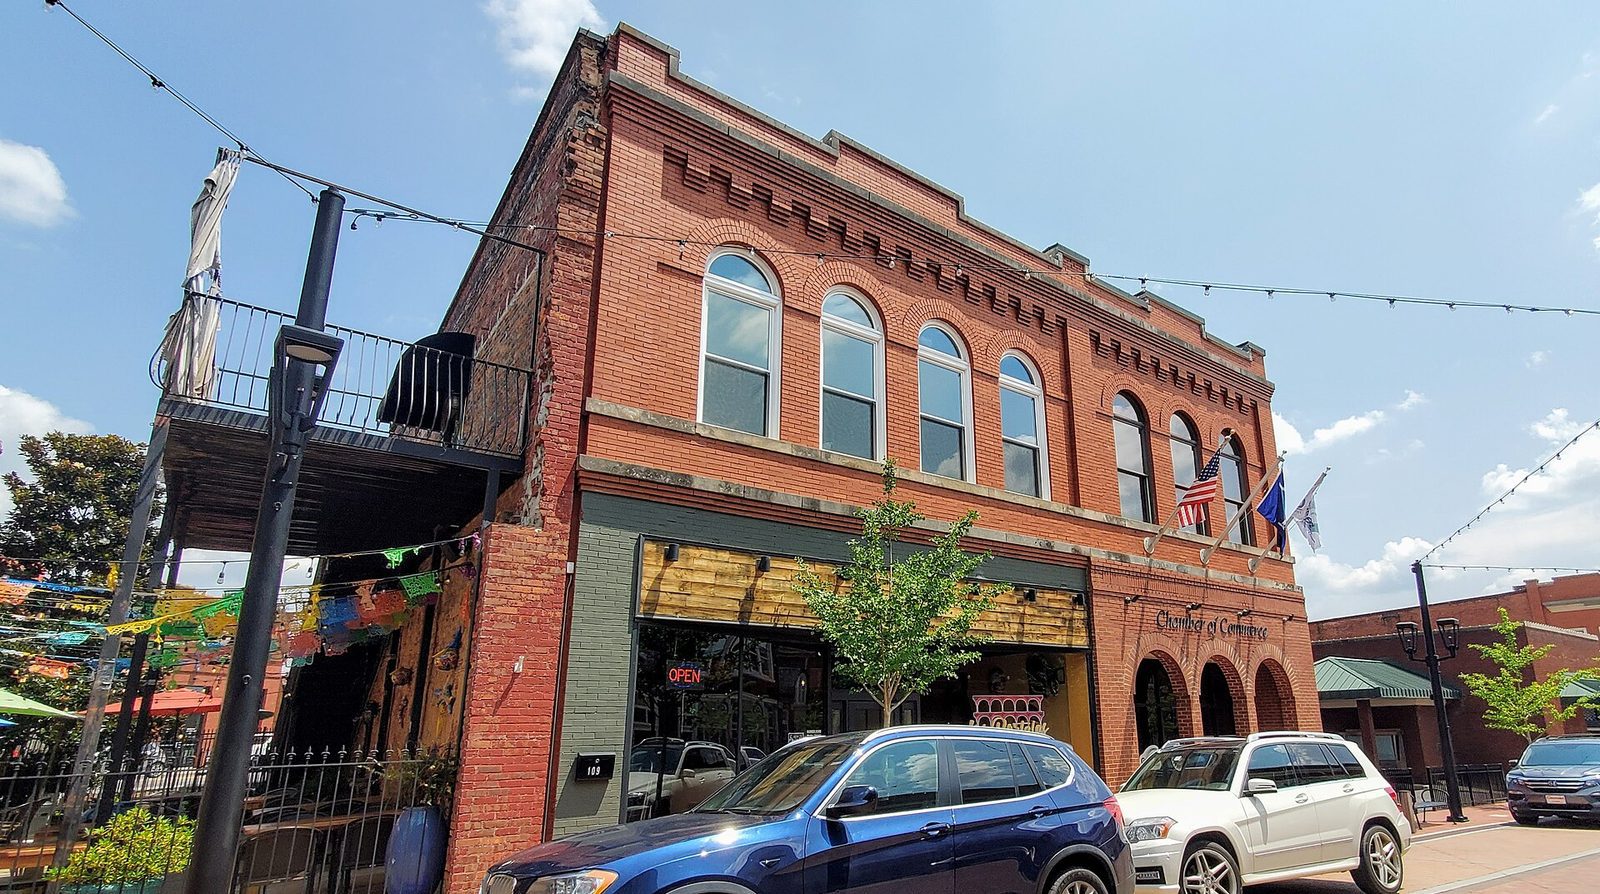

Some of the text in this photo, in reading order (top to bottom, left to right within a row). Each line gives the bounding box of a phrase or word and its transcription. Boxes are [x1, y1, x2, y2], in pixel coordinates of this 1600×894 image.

[1157, 610, 1205, 631] Chamber
[1220, 618, 1268, 638] Commerce
[669, 668, 700, 683] OPEN
[587, 766, 601, 776] 109
